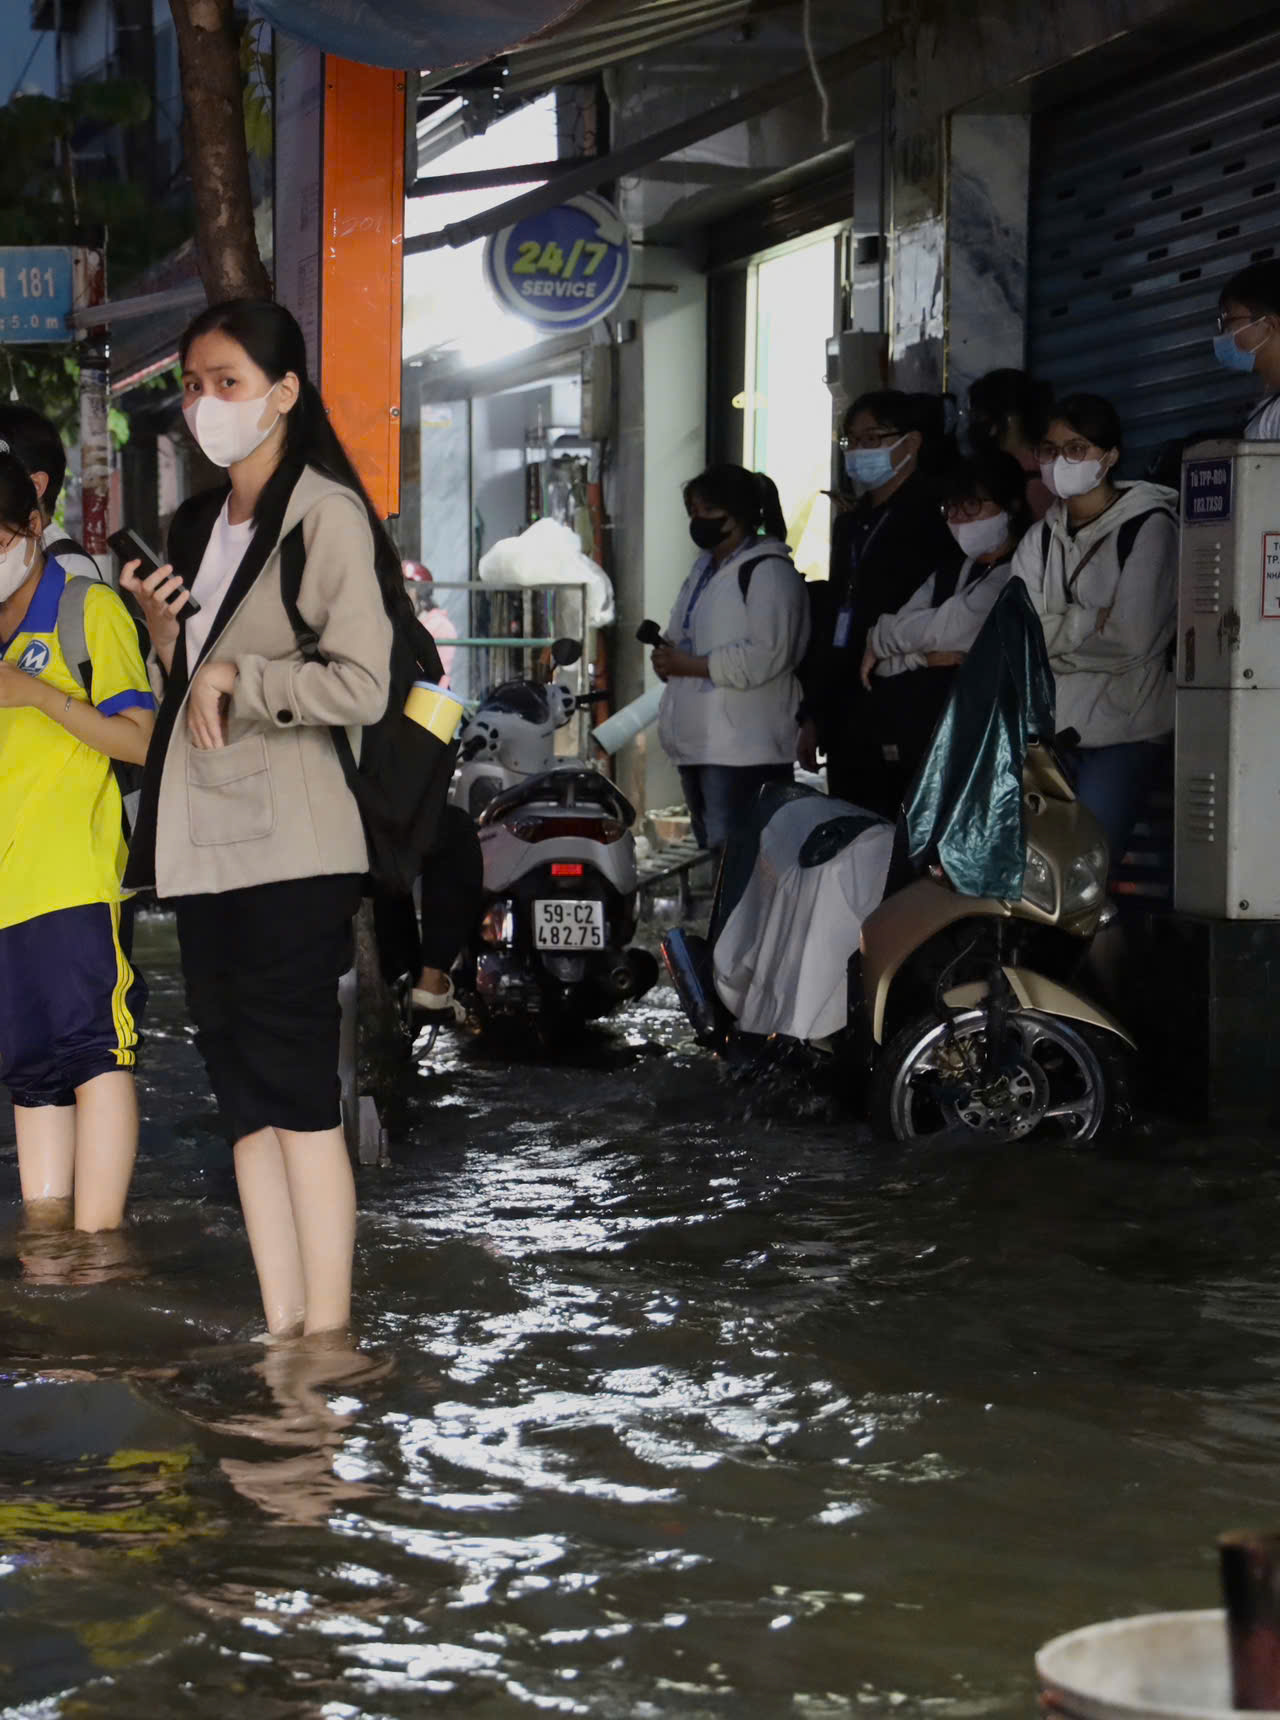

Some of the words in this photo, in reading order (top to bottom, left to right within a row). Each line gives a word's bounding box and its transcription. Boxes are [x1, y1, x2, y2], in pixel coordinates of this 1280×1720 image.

[512, 239, 609, 279] 24/7
[18, 267, 56, 298] 181
[521, 280, 598, 298] SERVICE
[1273, 542, 1280, 551] T
[543, 904, 594, 924] 59-C2
[538, 926, 601, 946] 482.75
